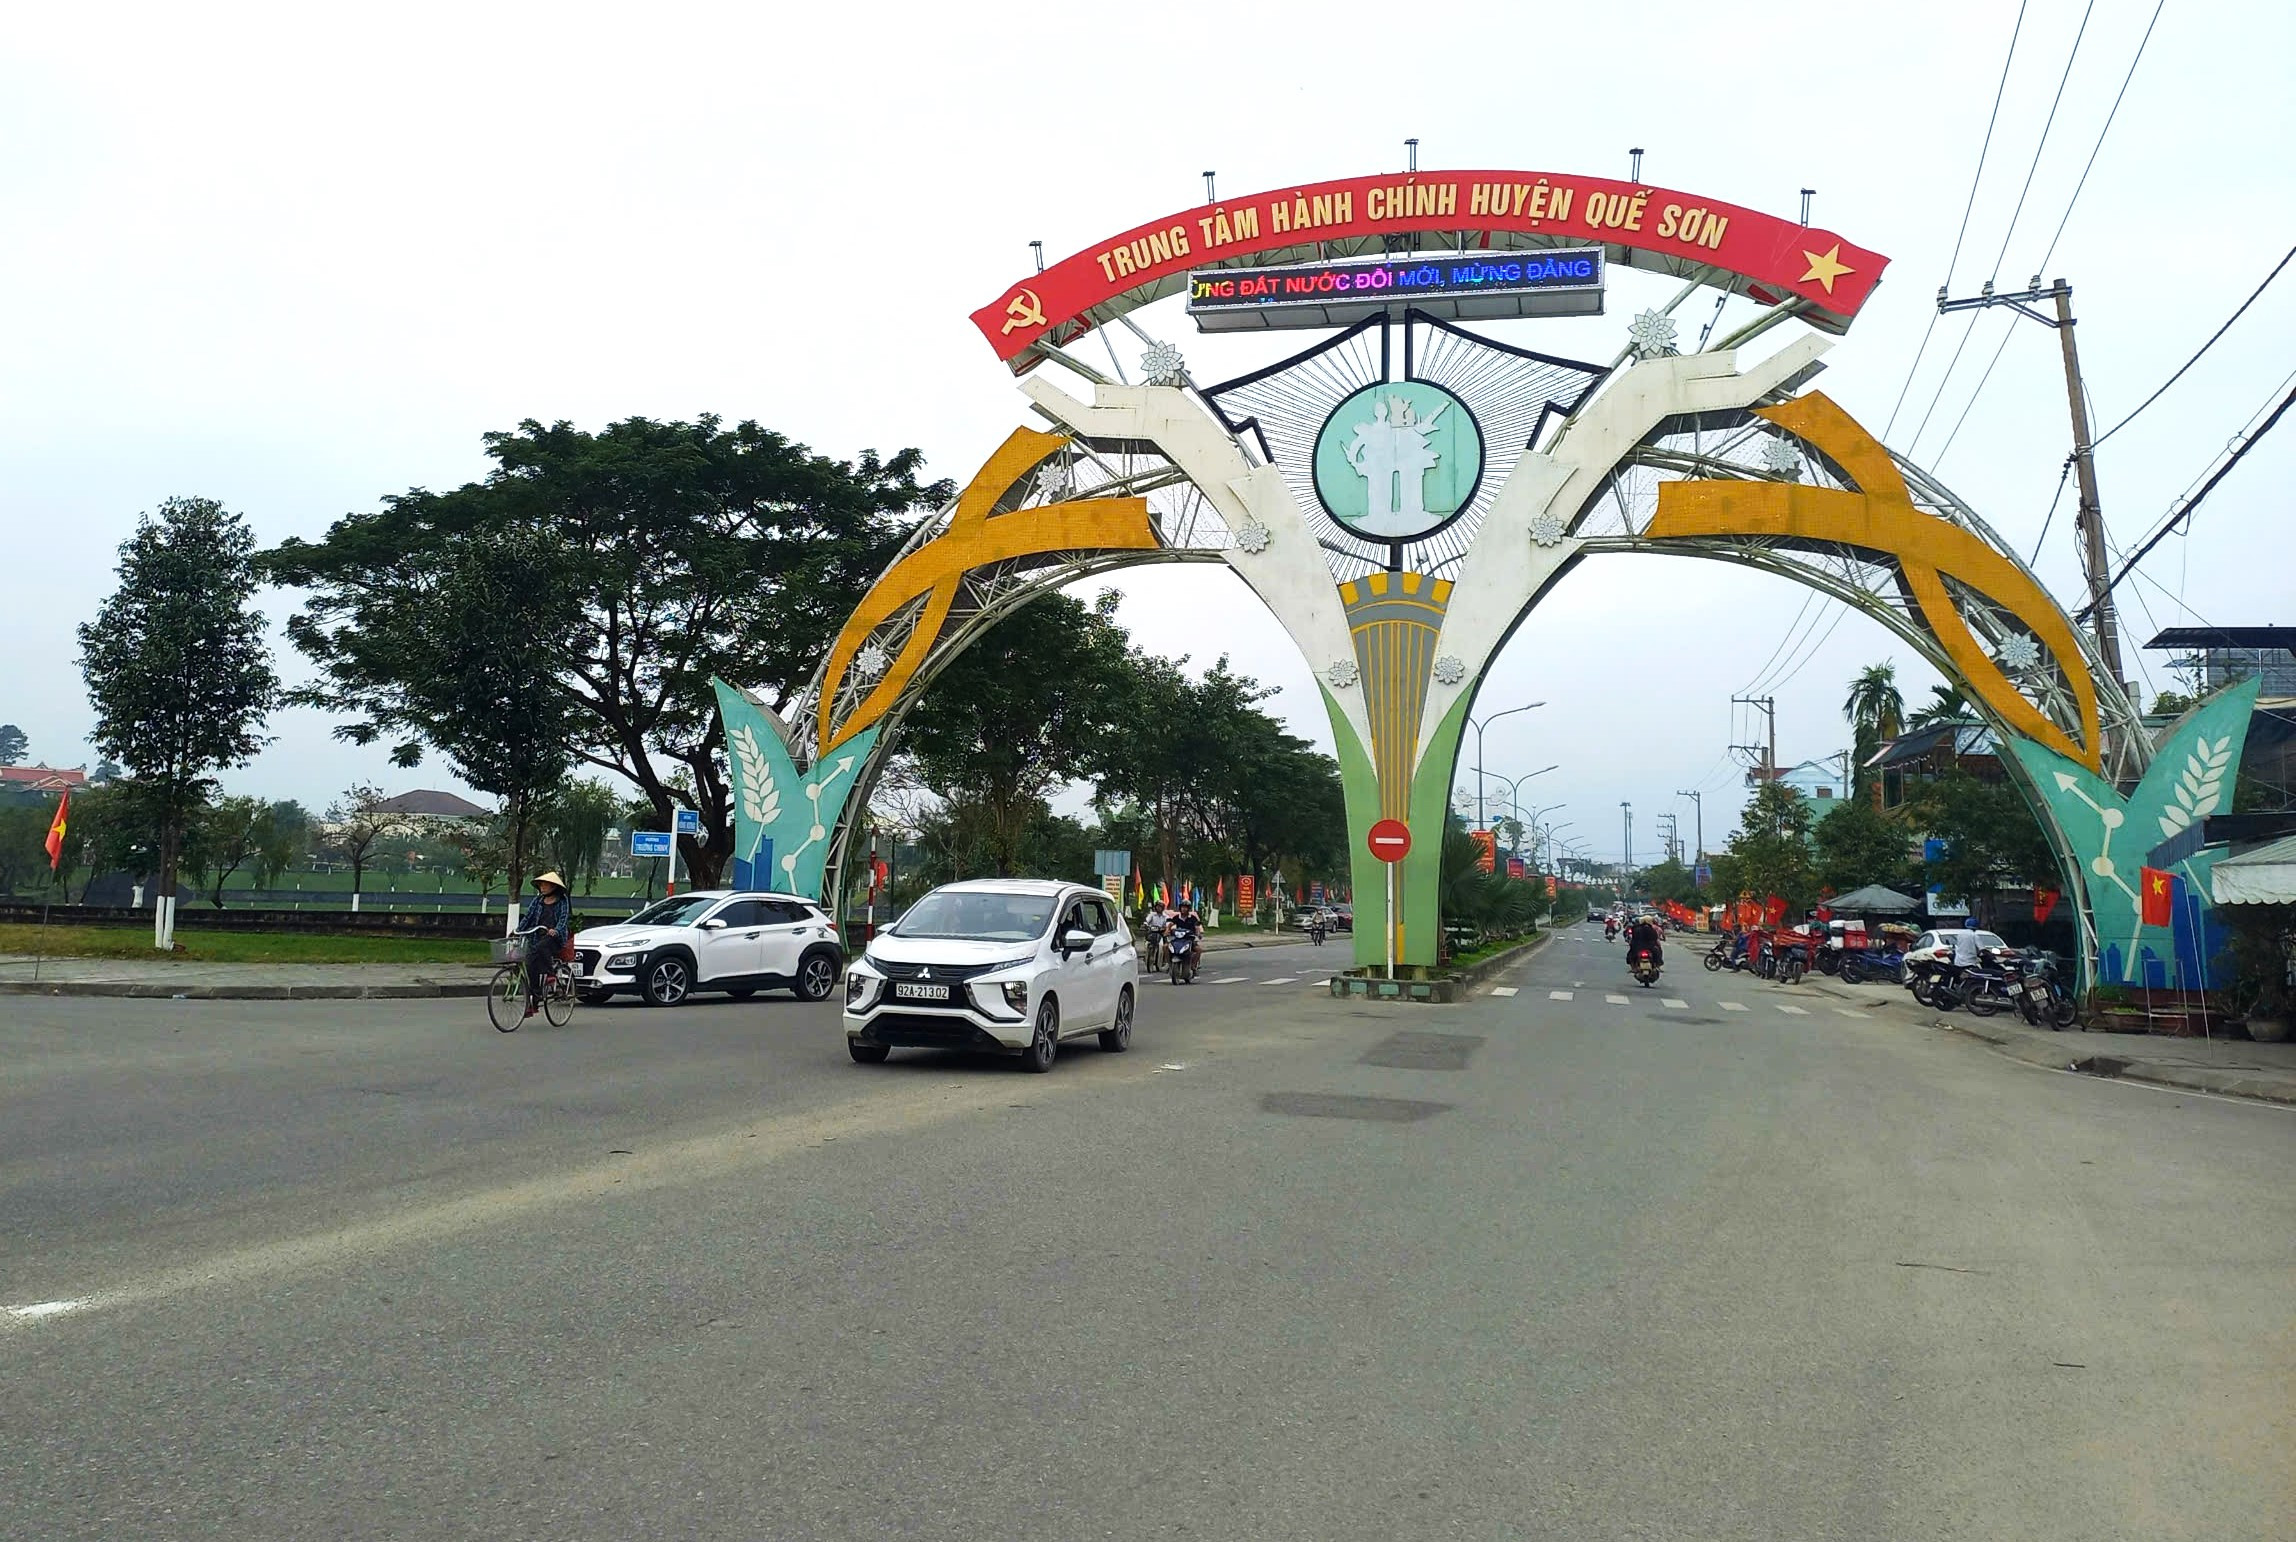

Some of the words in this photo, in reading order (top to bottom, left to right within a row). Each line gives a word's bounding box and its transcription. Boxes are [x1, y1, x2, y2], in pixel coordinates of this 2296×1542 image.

[1097, 225, 1191, 283] TRUNG
[1199, 207, 1260, 249] TÂM
[1271, 191, 1353, 234] HÀNH
[1367, 177, 1458, 220] CHÍNH
[1469, 178, 1574, 226] HUYỆN
[1585, 189, 1655, 231] QUẾ
[1656, 204, 1729, 250] SƠN
[1285, 272, 1350, 294] NƯỚC
[1399, 265, 1445, 287] MỚI,
[1452, 262, 1521, 284] MỪNG
[1527, 258, 1592, 280] ĐẢNG
